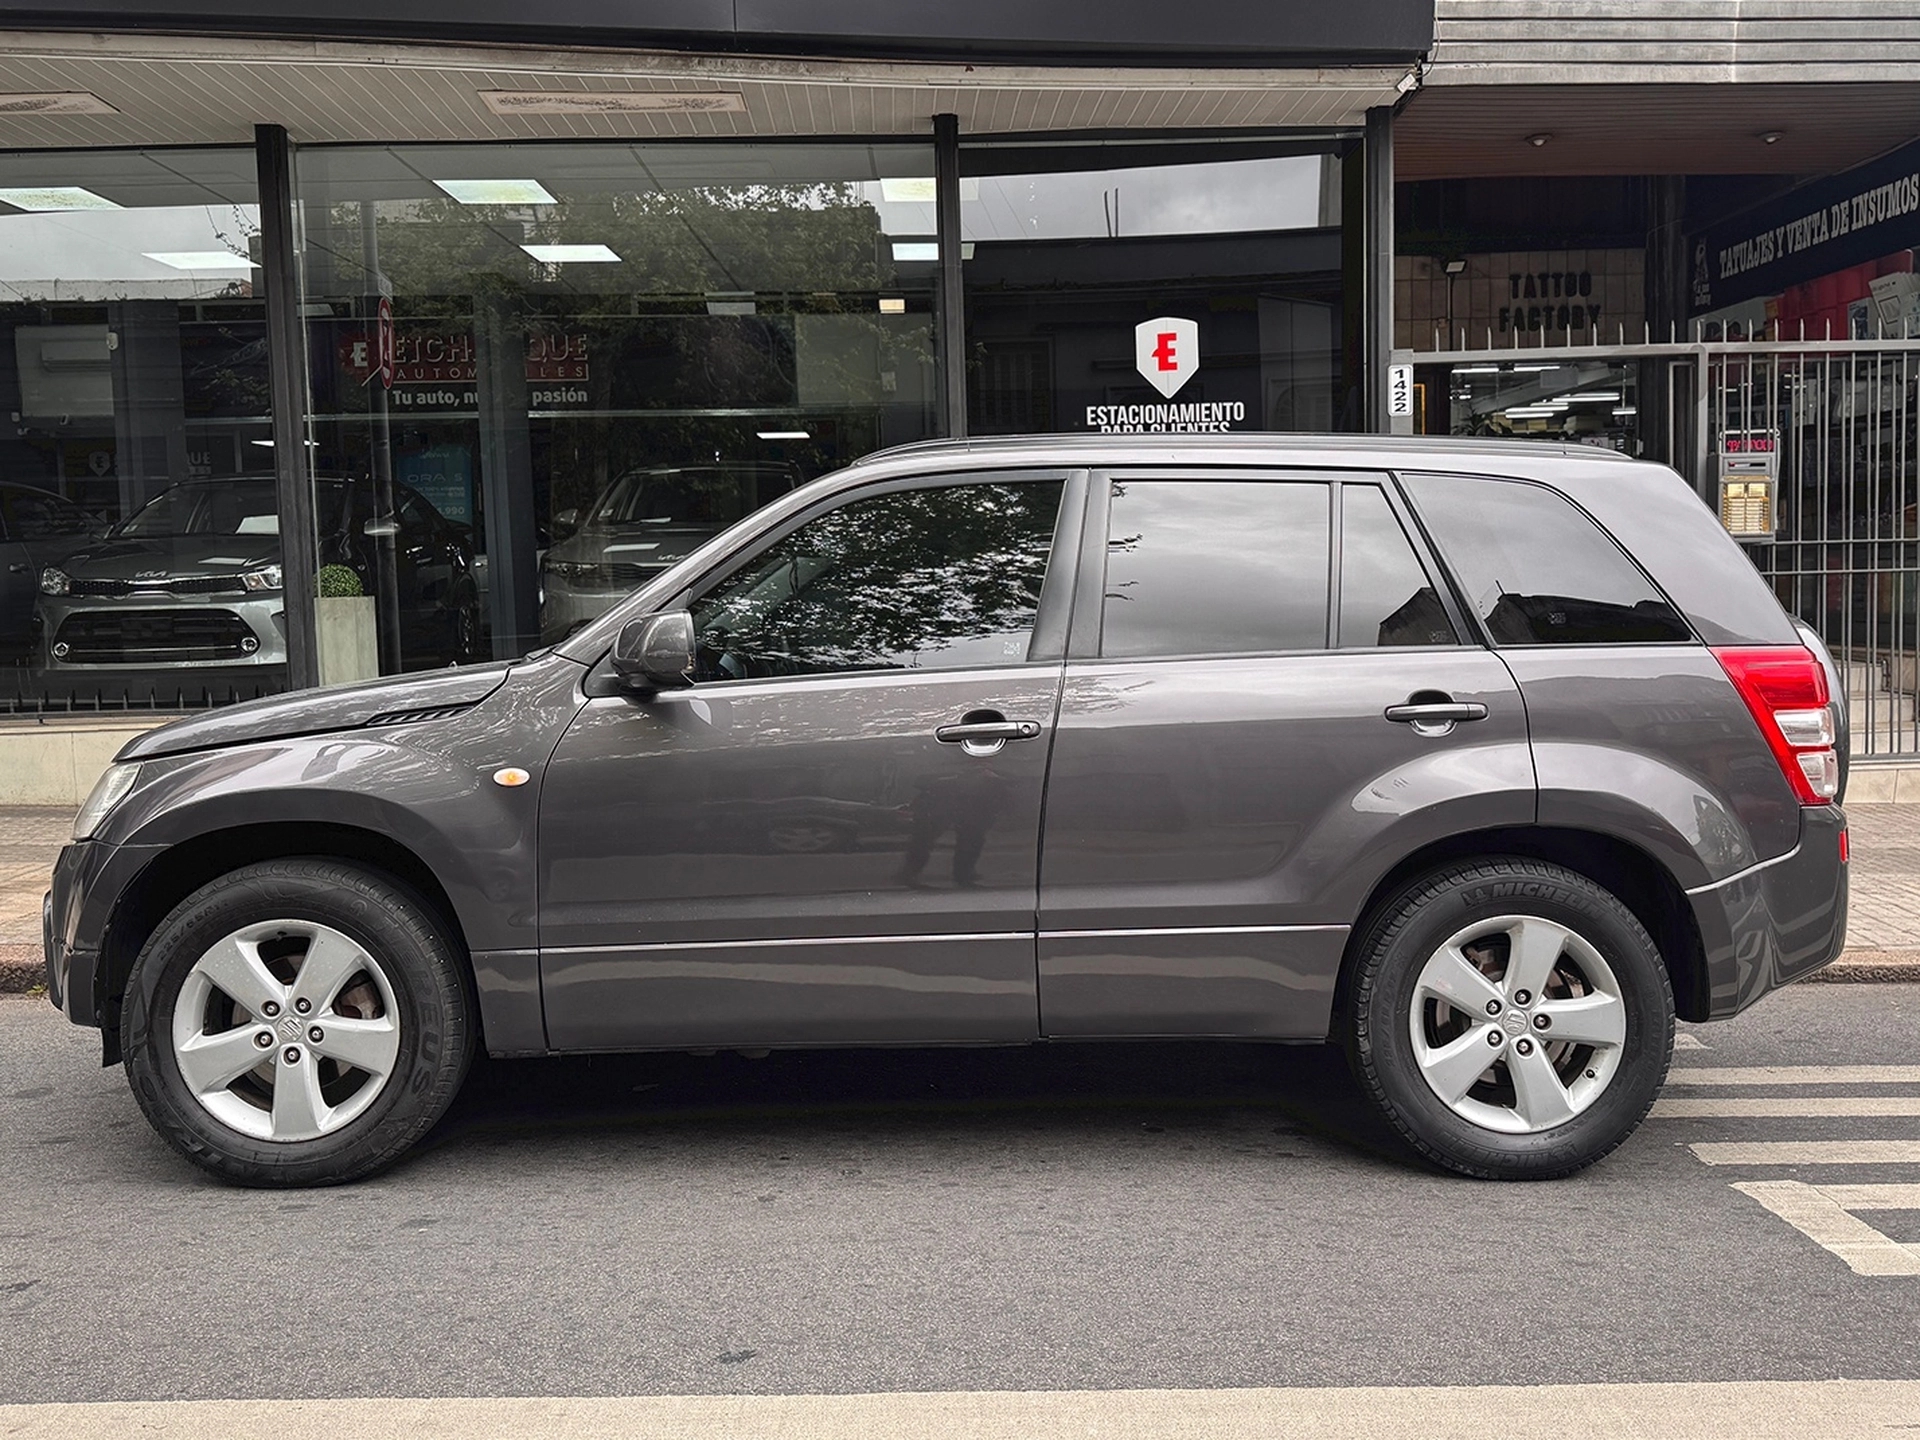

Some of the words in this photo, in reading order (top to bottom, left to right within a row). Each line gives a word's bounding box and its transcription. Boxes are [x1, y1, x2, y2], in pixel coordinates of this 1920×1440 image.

[1719, 230, 1774, 279] TATUAJES
[1776, 226, 1786, 259] Y
[1785, 209, 1829, 254] VENTA
[1831, 200, 1849, 238] DE
[1851, 173, 1920, 231] INSUMOS
[1509, 271, 1592, 299] TATTOO
[1499, 304, 1601, 333] FACTORY
[393, 390, 412, 405] Tu
[416, 391, 459, 407] auto,
[532, 387, 588, 406] pasión
[1393, 369, 1407, 412] 1422
[1086, 402, 1245, 426] ESTACIONAMIENTO
[1491, 882, 1605, 917] MICHELIN
